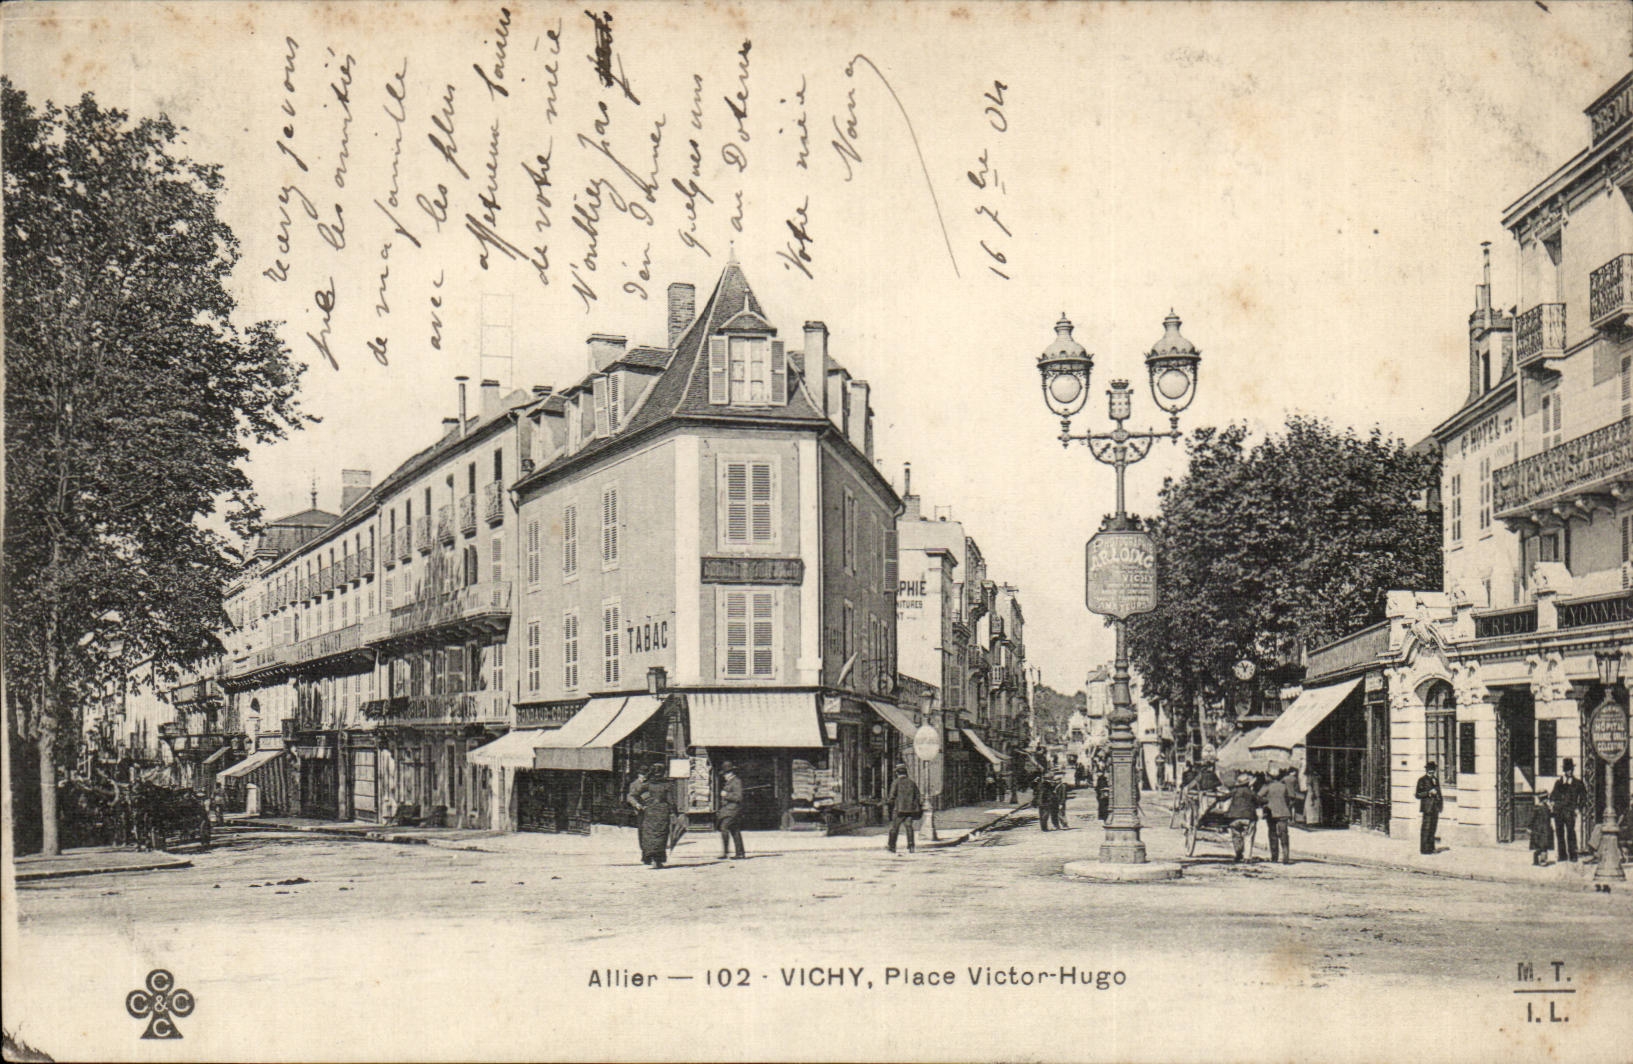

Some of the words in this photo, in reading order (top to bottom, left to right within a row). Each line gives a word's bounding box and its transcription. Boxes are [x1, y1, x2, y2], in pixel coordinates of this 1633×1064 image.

[276, 35, 299, 115] vous
[690, 73, 703, 128] uns
[374, 57, 420, 246] famille
[429, 82, 468, 178] plus
[577, 99, 643, 182] pas
[522, 135, 551, 231] votre
[629, 112, 666, 225] donner
[672, 140, 714, 256] quelques
[318, 204, 346, 249] les
[416, 183, 448, 231] les
[729, 190, 743, 231] au
[776, 194, 813, 279] Votre
[376, 240, 392, 315] ma
[530, 245, 549, 285] de
[980, 239, 1009, 279] 16
[430, 269, 443, 348] avec
[367, 336, 389, 365] de
[899, 580, 927, 596] PHIE
[627, 621, 668, 654] TABAC
